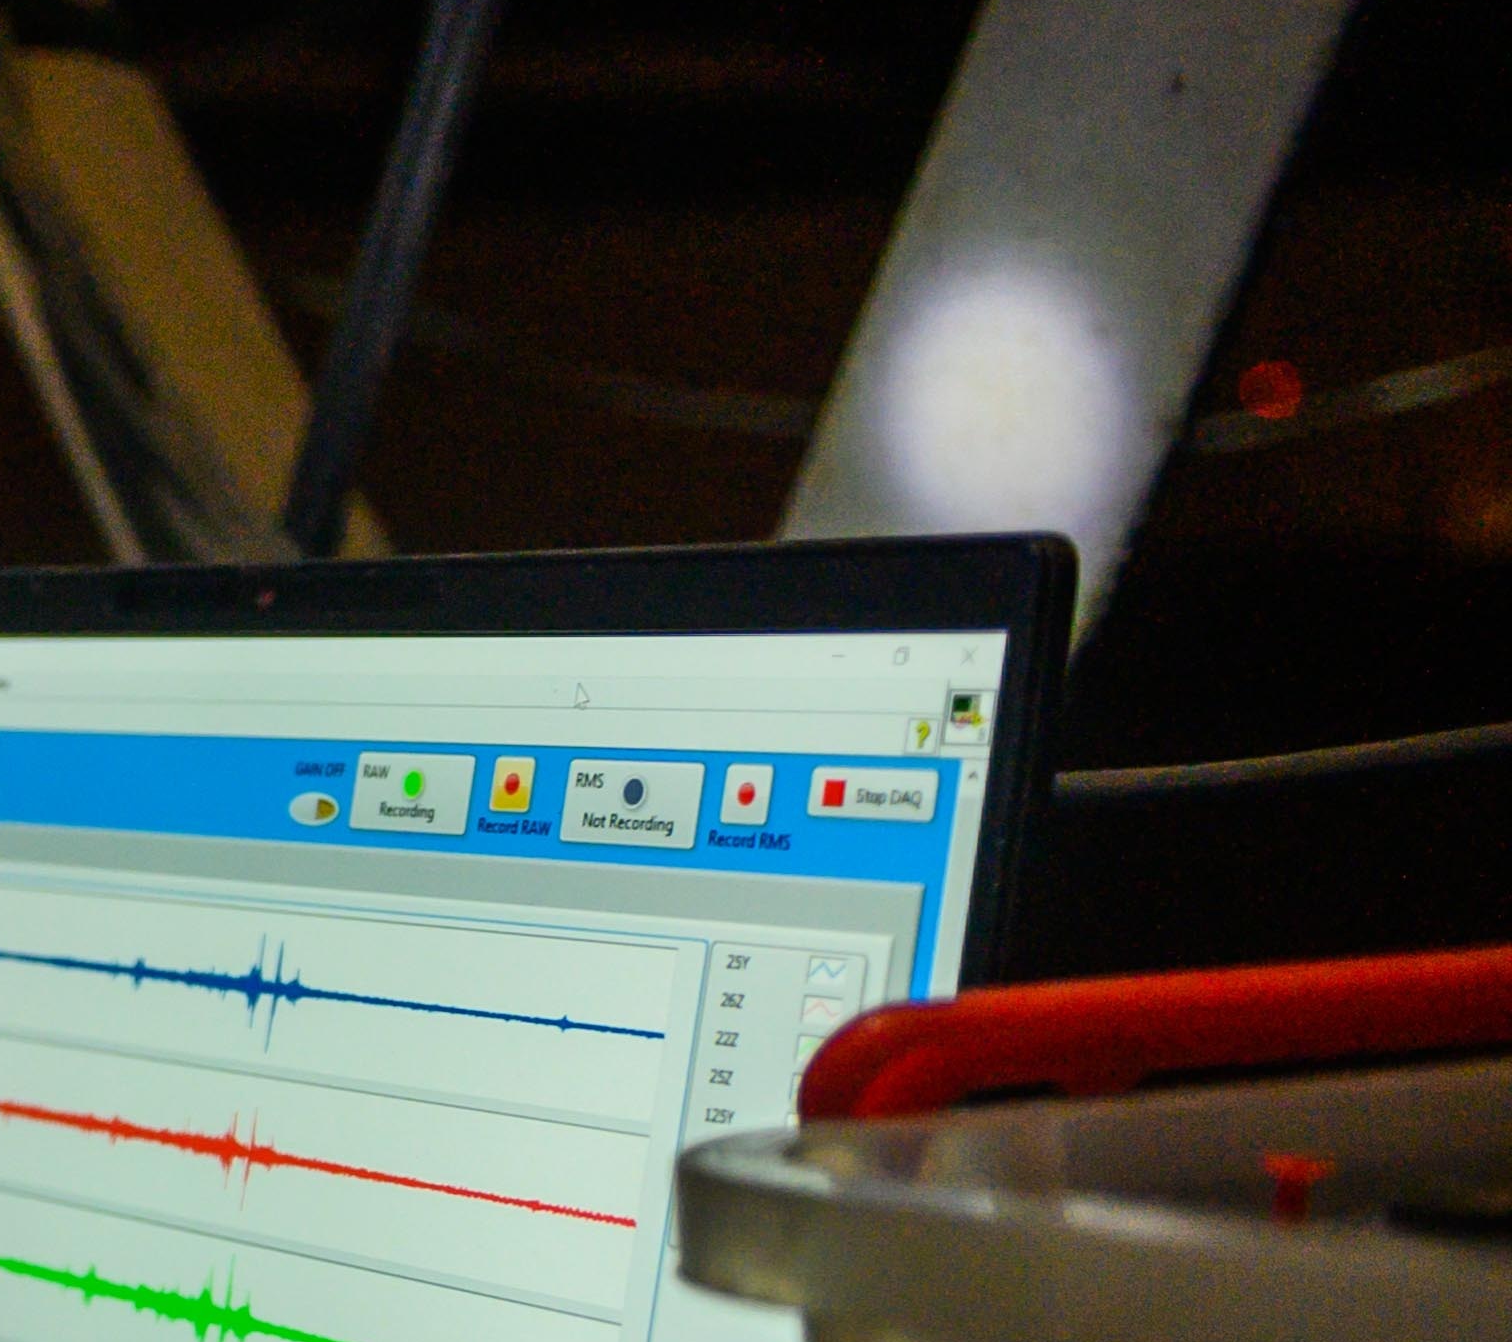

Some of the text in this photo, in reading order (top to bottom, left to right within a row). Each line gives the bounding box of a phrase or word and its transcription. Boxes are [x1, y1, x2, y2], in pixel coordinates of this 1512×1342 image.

[324, 763, 346, 777] OFF
[363, 763, 391, 779] RAW
[575, 772, 604, 789] RMS
[856, 789, 923, 809] Stop DAQ
[379, 801, 435, 823] Recording
[477, 817, 552, 836] Record RAW
[581, 813, 674, 836] Not Recording
[708, 830, 792, 851] Record RMS
[726, 954, 751, 970] 25Y
